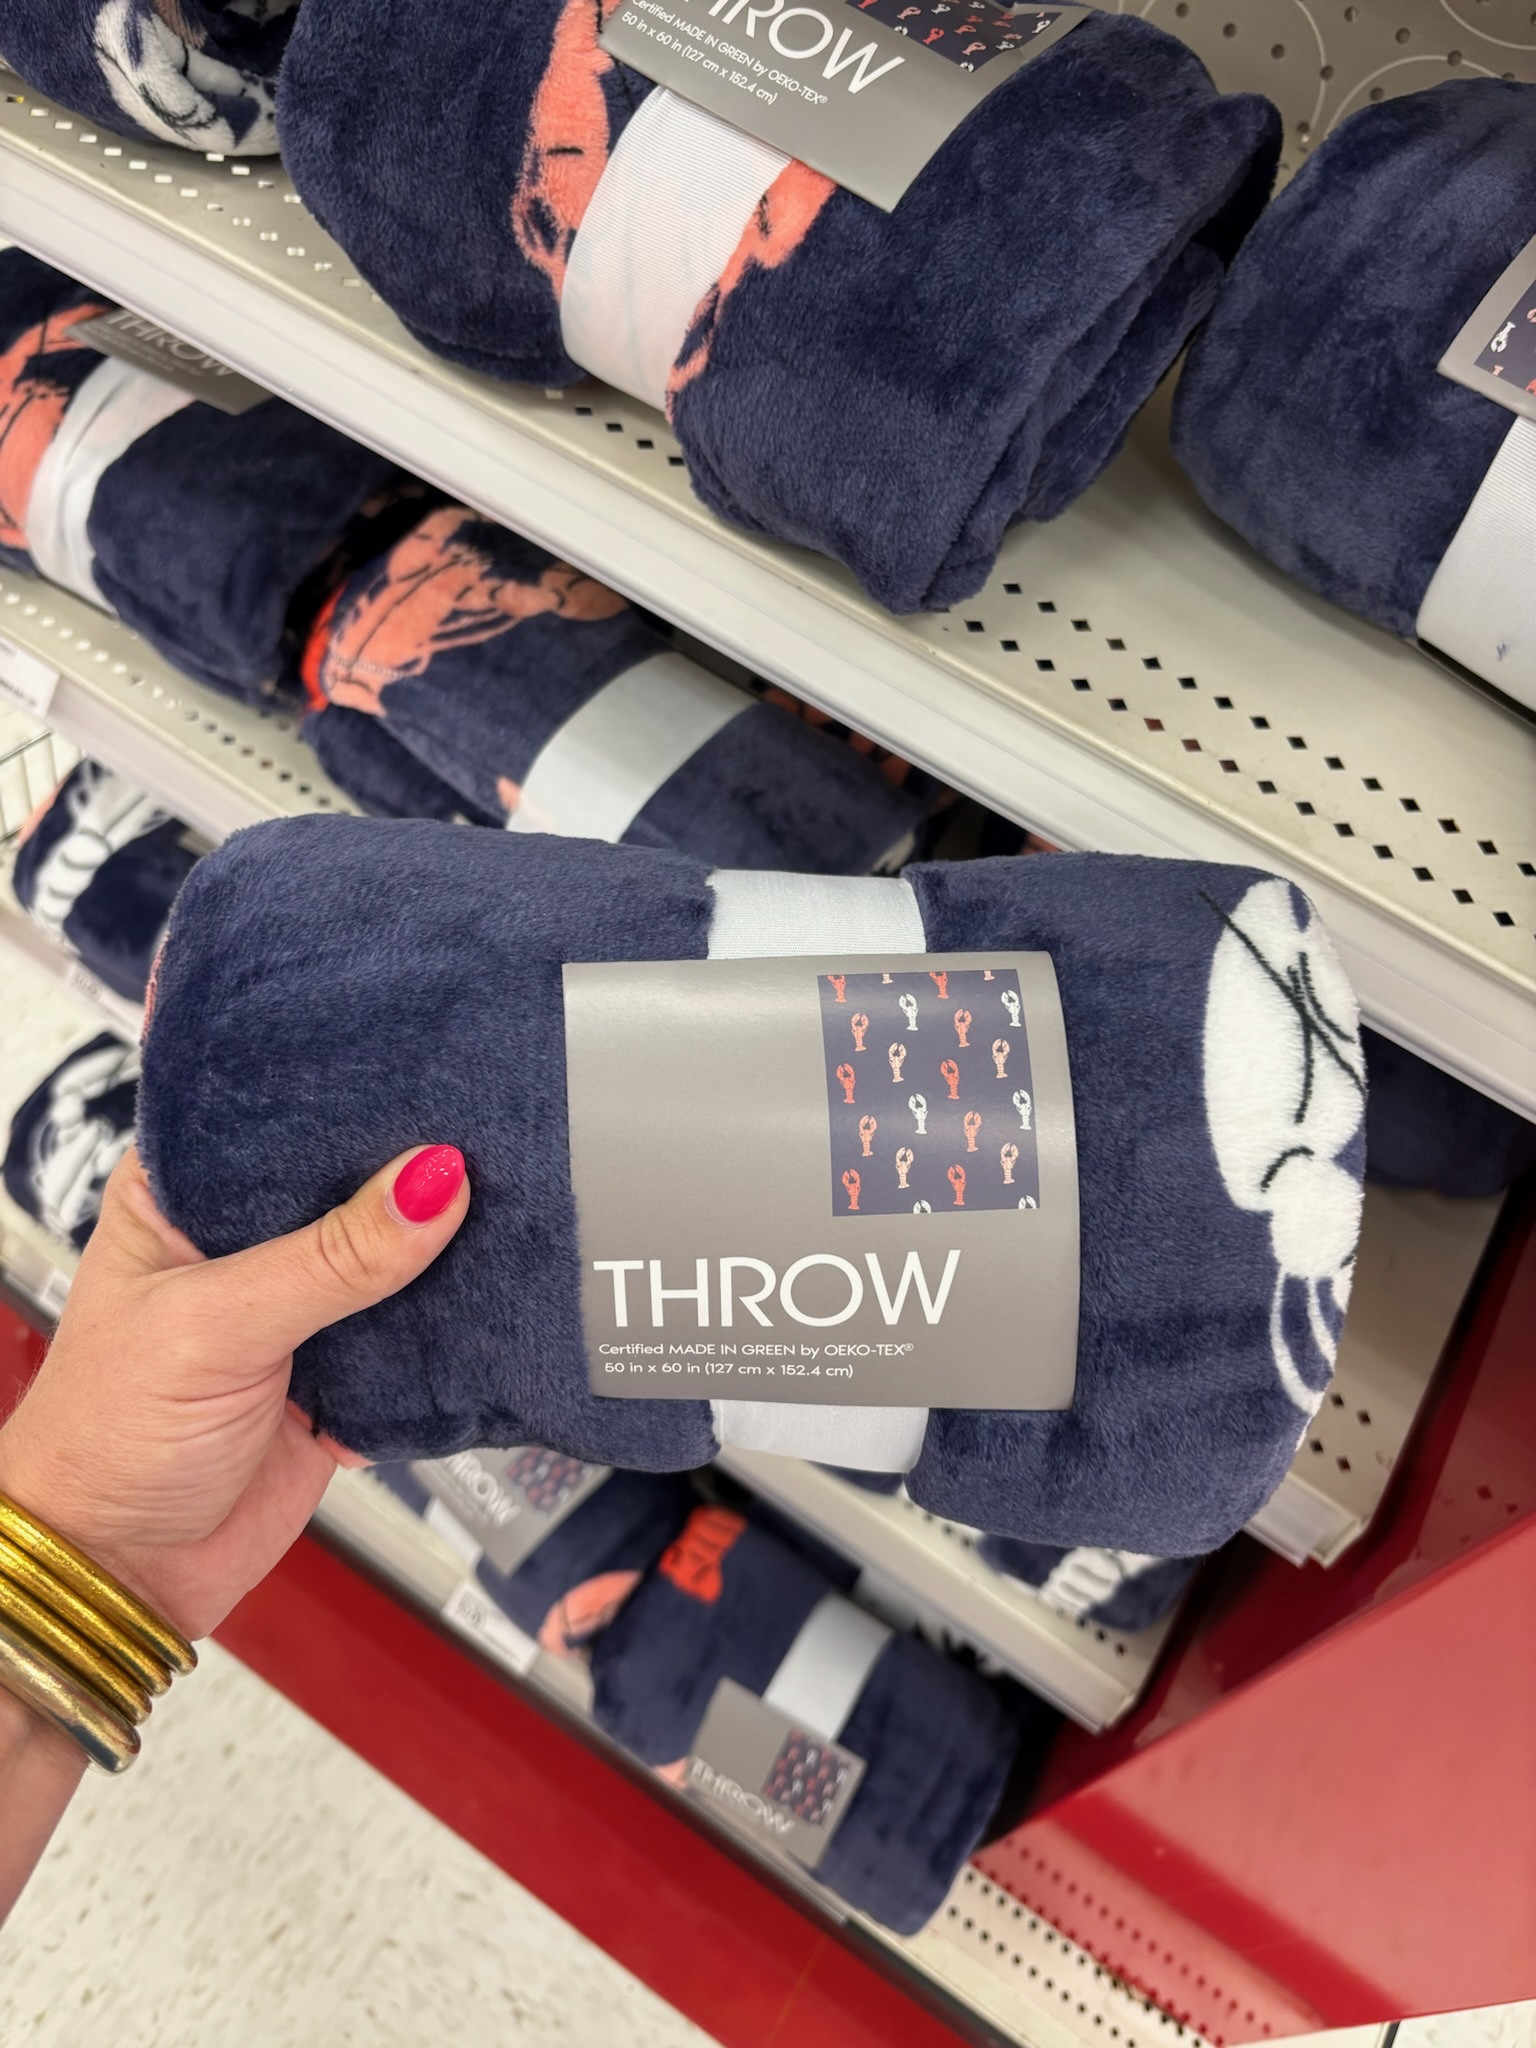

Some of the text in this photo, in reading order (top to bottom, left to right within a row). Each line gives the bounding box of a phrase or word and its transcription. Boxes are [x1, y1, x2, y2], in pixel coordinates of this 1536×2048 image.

[621, 11, 779, 106] 50 in x 60 in (127 cm x 152.4 cm)
[632, 0, 829, 105] Certified MADE IN GREEN by OEKO-TEX®
[593, 1249, 962, 1328] THROW
[598, 1342, 915, 1360] Certified MADE IN GREEN by OEKO-TEX®
[604, 1361, 854, 1379] 50 in x 60 in (127 cm x 152.4 cm)
